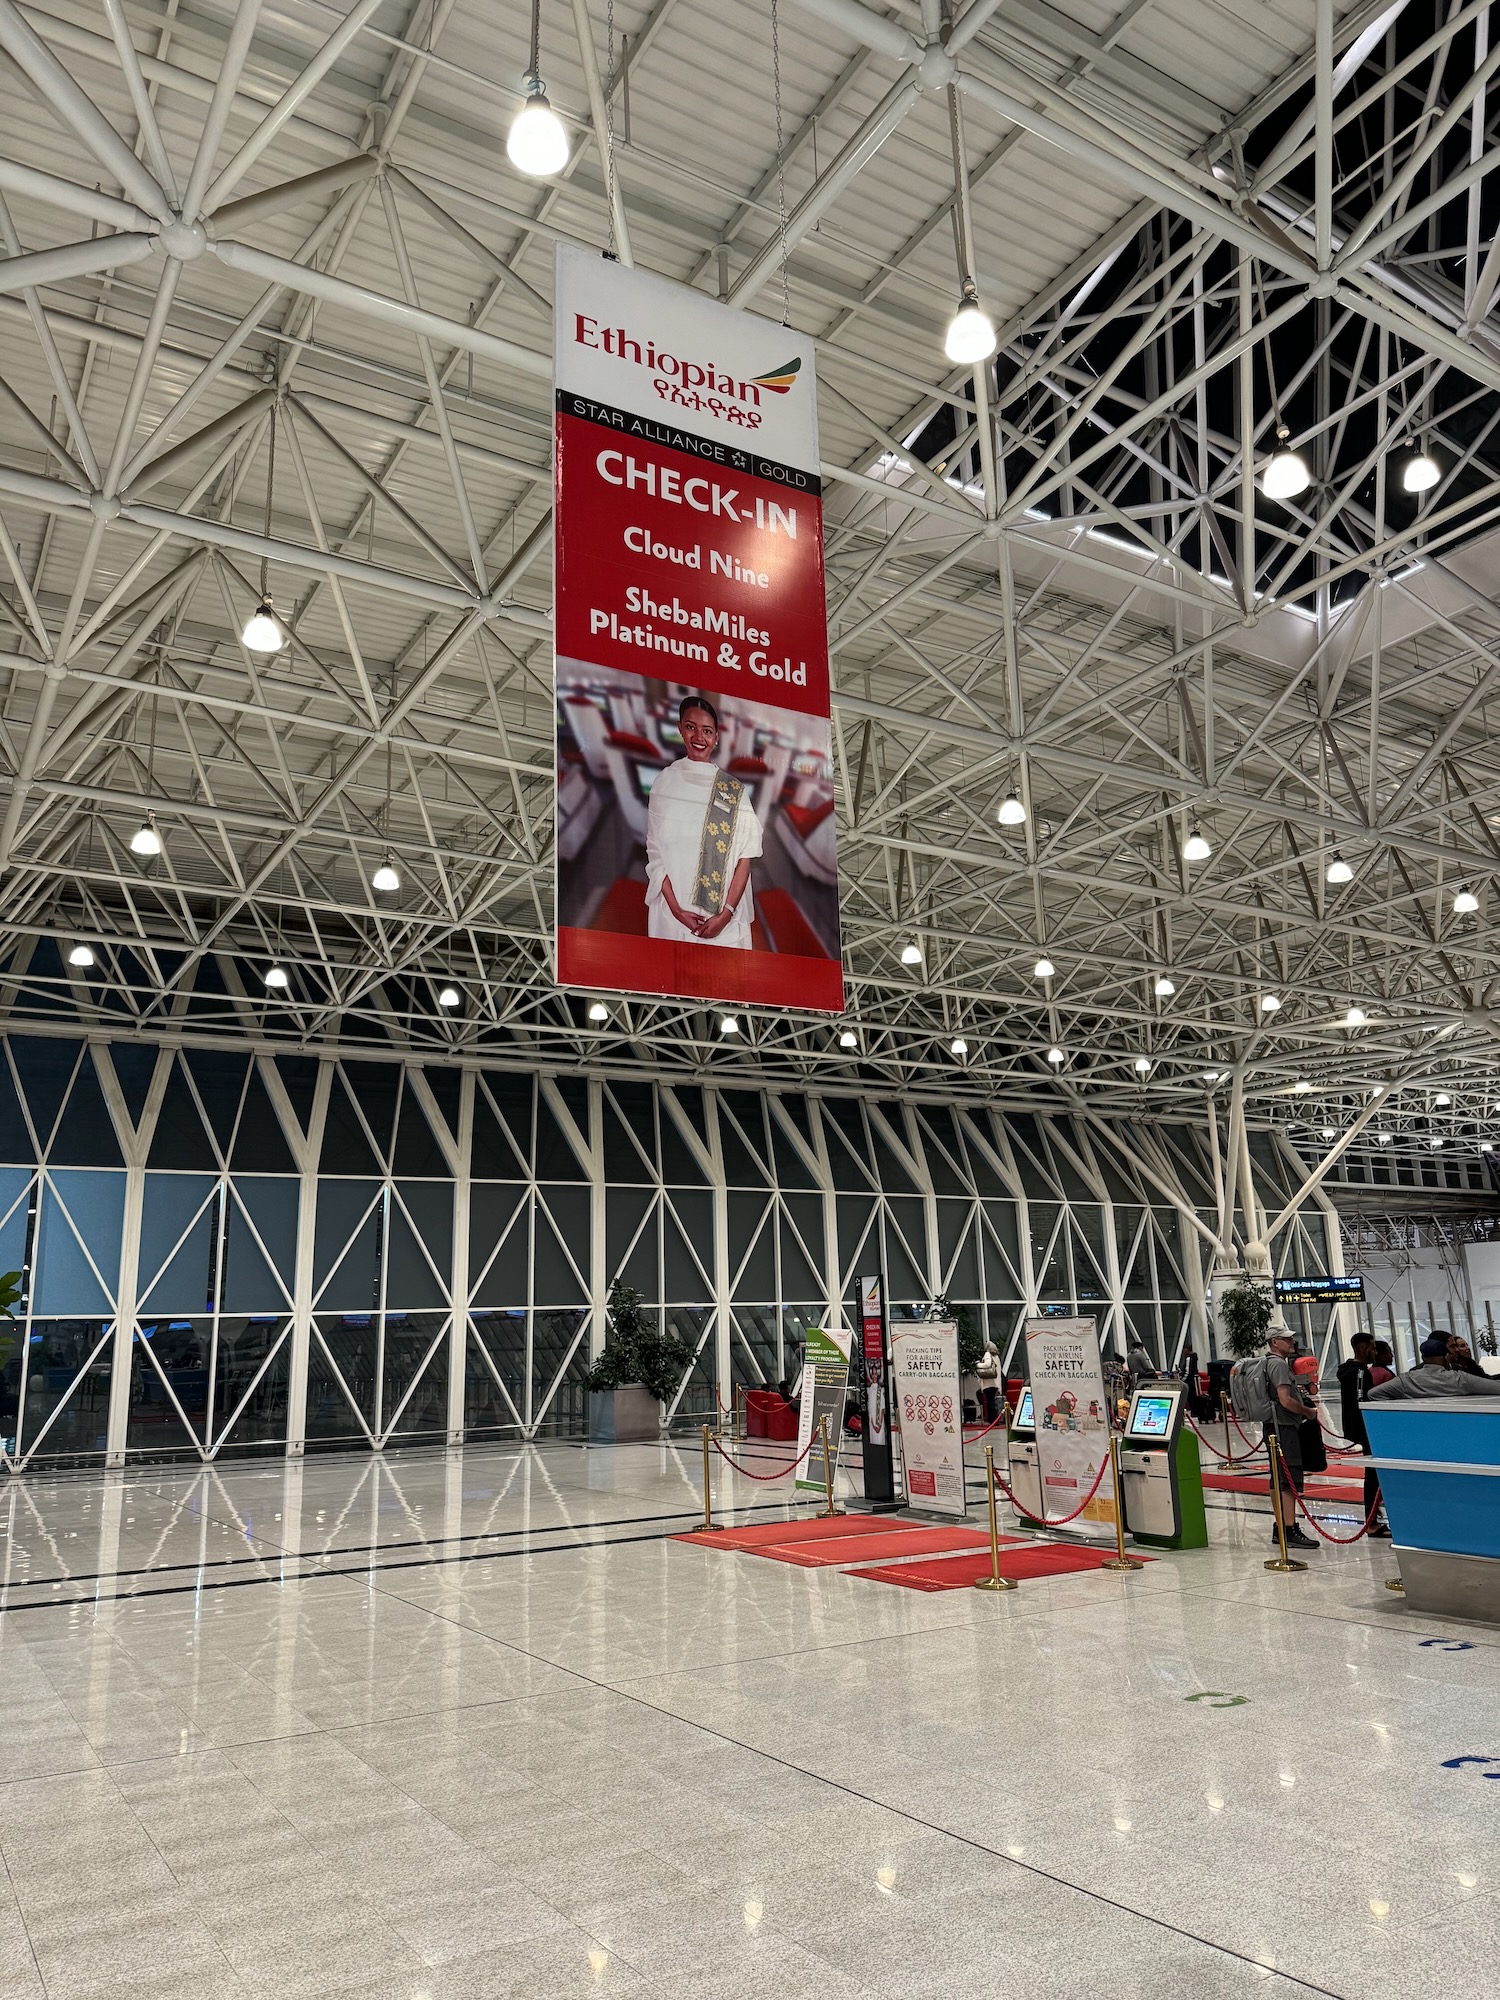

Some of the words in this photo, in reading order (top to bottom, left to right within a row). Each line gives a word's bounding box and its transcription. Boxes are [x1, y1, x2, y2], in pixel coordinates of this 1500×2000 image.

[574, 312, 762, 407] Ethiopian
[653, 378, 762, 429] የኢትዮጵያ
[574, 400, 624, 428] STAR
[631, 420, 725, 462] ALLIANCE
[760, 462, 807, 487] GOLD
[596, 450, 797, 539] CHECK-IN
[623, 526, 701, 570] Cloud
[710, 550, 769, 588] Nine
[626, 586, 771, 646] ShebaMiles
[590, 608, 709, 663] Platinum
[717, 643, 742, 670] &
[749, 651, 807, 687] Gold
[857, 1324, 865, 1379] ALLIANCE
[907, 1361, 943, 1370] SAFETY
[1045, 1360, 1084, 1370] SAFETY
